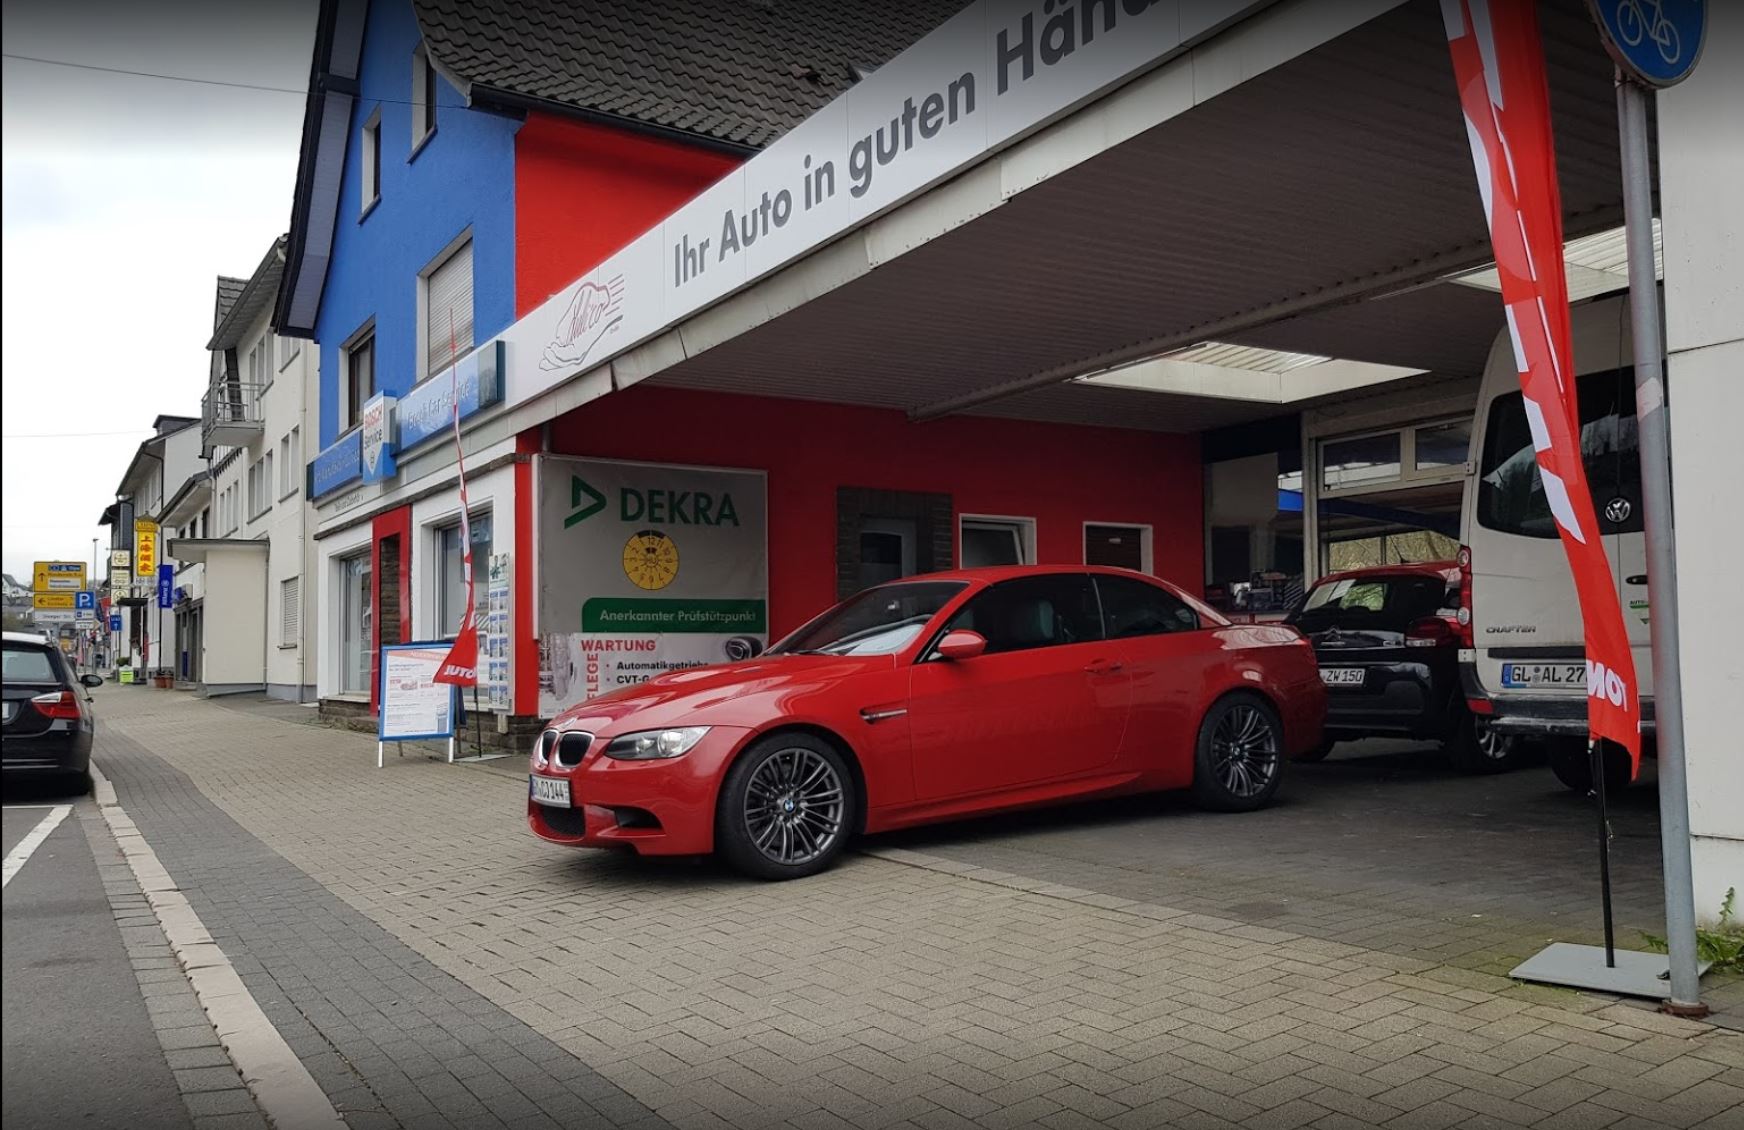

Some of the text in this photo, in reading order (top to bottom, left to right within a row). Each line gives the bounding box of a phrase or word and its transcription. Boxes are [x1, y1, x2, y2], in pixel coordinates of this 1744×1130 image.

[674, 233, 710, 288] Ihr
[718, 189, 792, 263] Auto
[804, 154, 835, 211] in
[849, 72, 975, 198] guten
[620, 487, 739, 526] DEKRA
[79, 593, 91, 608] P
[599, 610, 756, 624] Anerkannter Prüfstützpunkt
[1485, 625, 1537, 633] CRAFTER
[581, 640, 656, 651] WARTUNG
[1341, 670, 1363, 682] 150
[1512, 666, 1588, 682] GL AL 27
